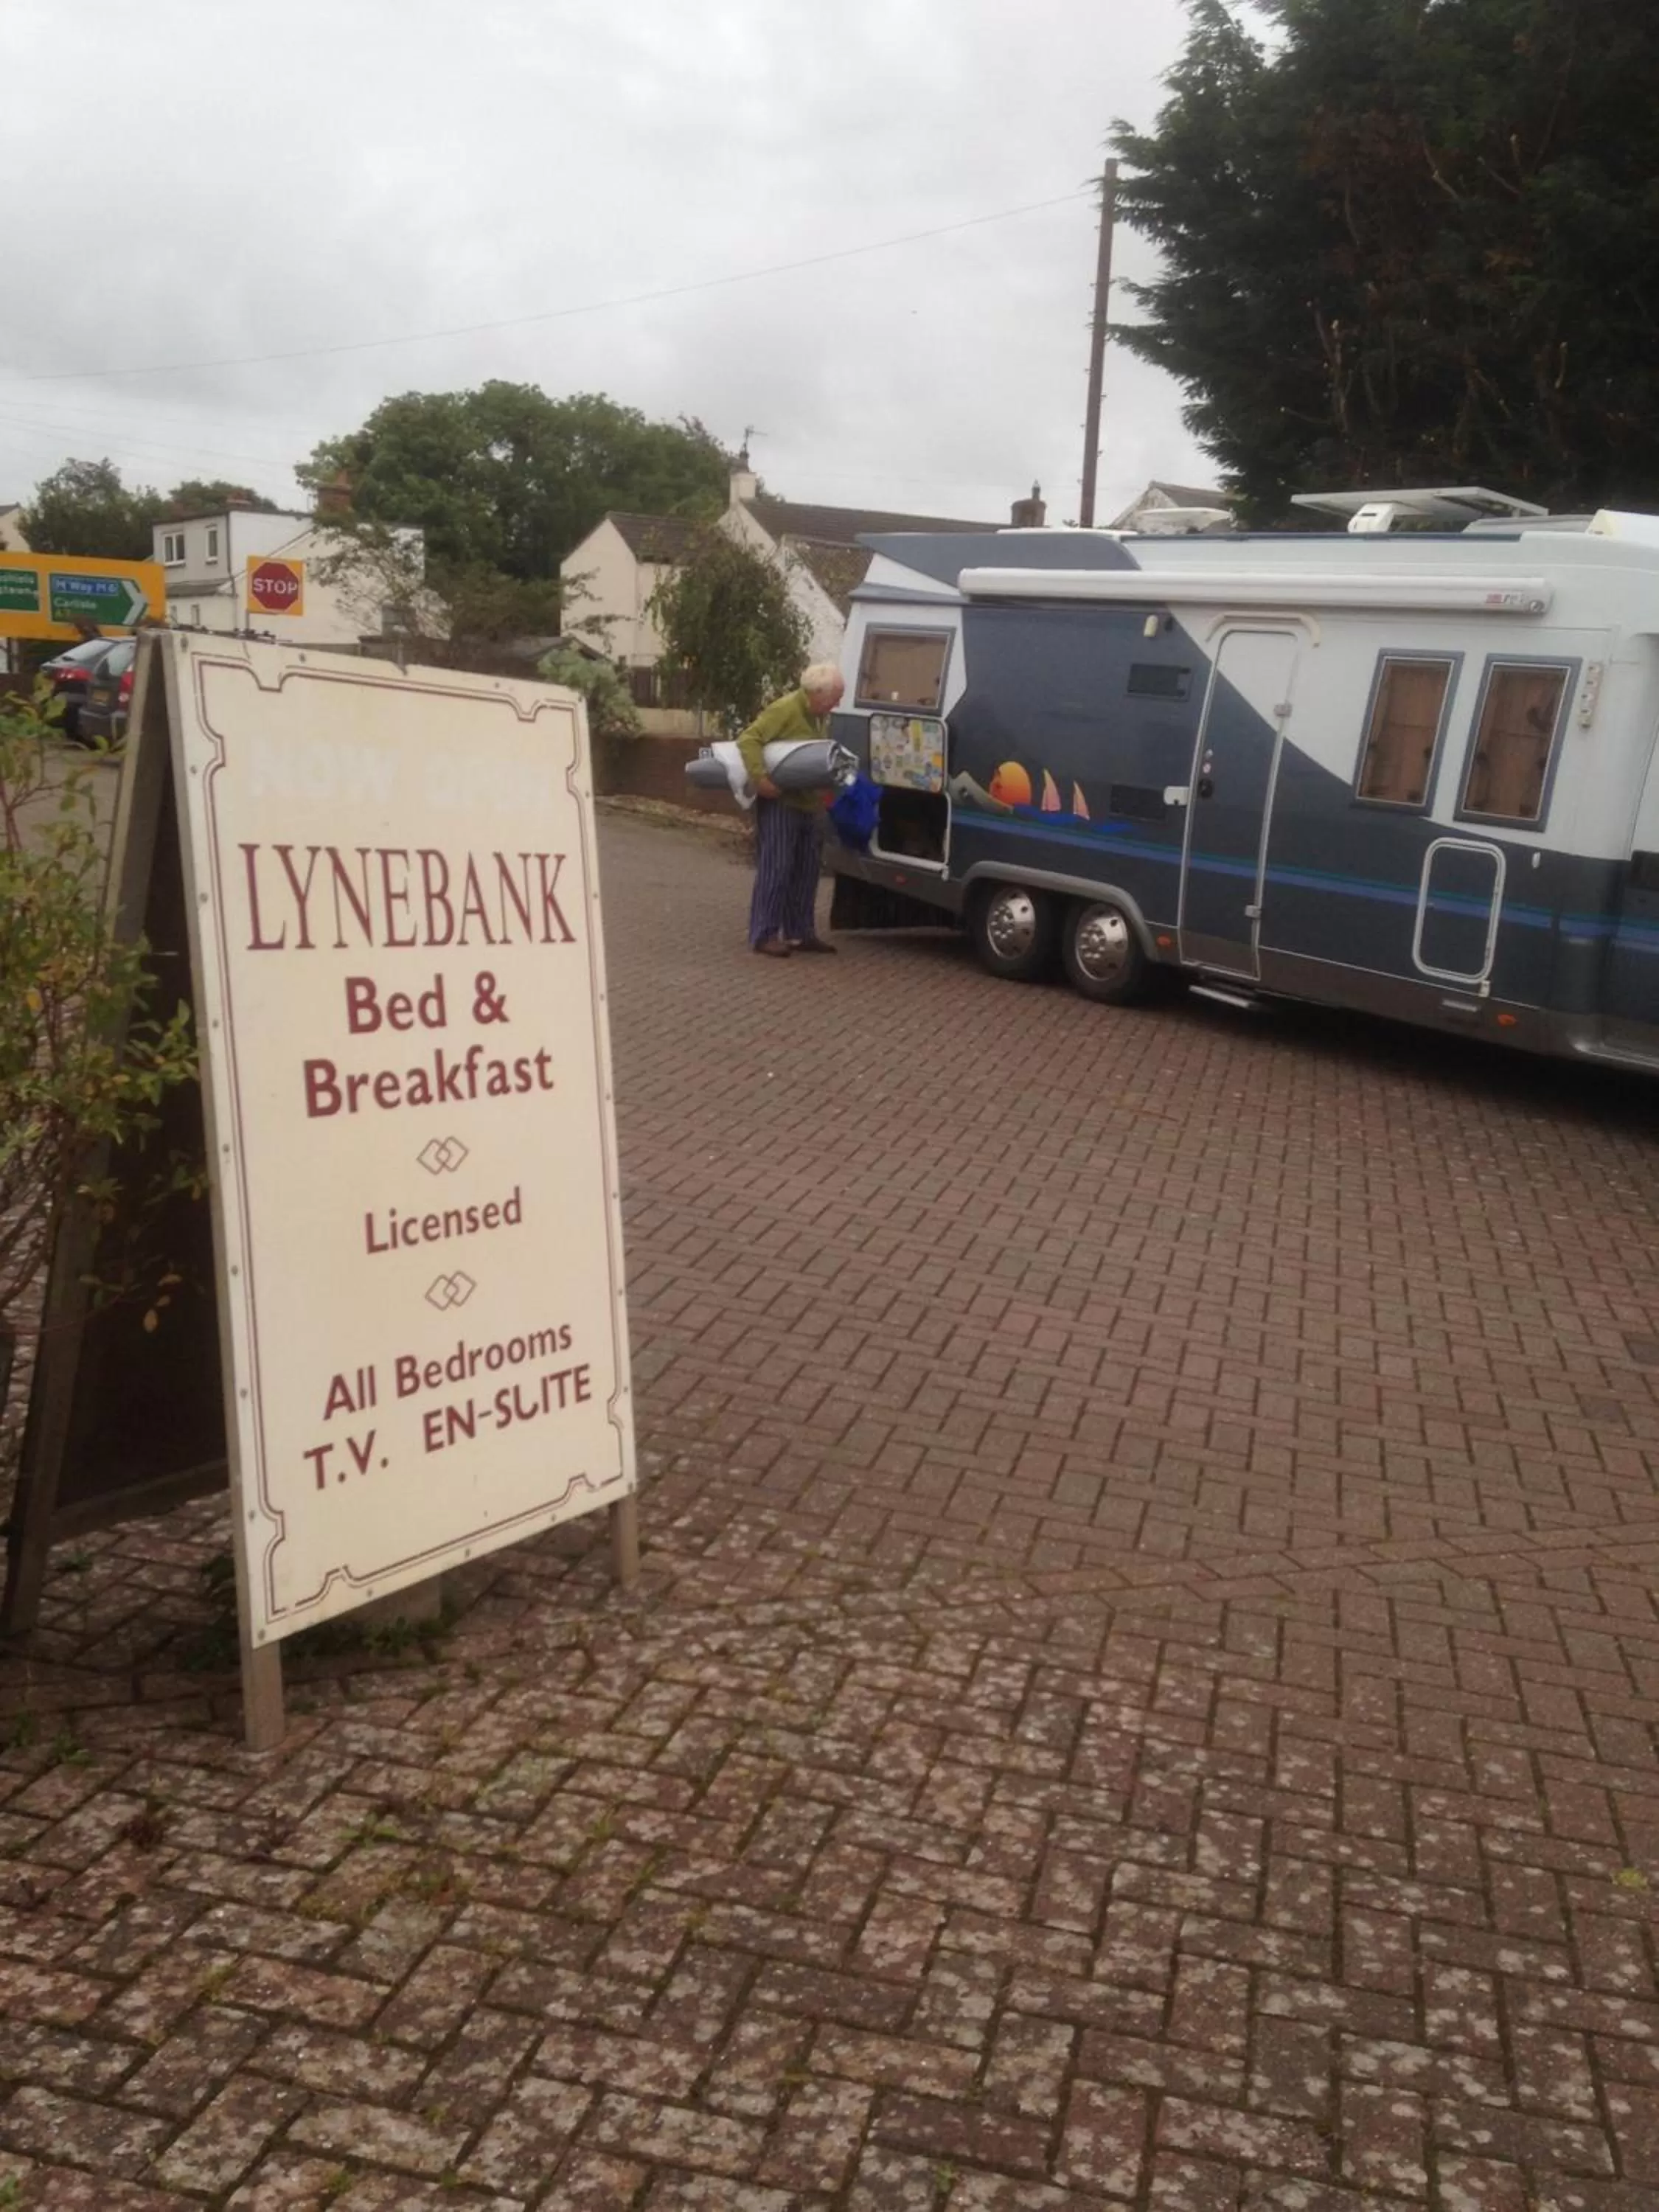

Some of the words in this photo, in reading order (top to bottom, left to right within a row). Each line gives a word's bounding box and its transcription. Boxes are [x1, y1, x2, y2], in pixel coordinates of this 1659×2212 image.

[254, 577, 298, 595] STOP
[237, 844, 577, 950] LYNEBANK
[345, 973, 447, 1034] Bed
[472, 970, 510, 1025] &
[303, 1045, 554, 1119] Breakfast
[364, 1185, 523, 1255] Licensed
[323, 1365, 378, 1421] All
[394, 1324, 573, 1399] Bedrooms
[303, 1429, 389, 1491] T.V.
[422, 1363, 593, 1454] EN-SUITE
